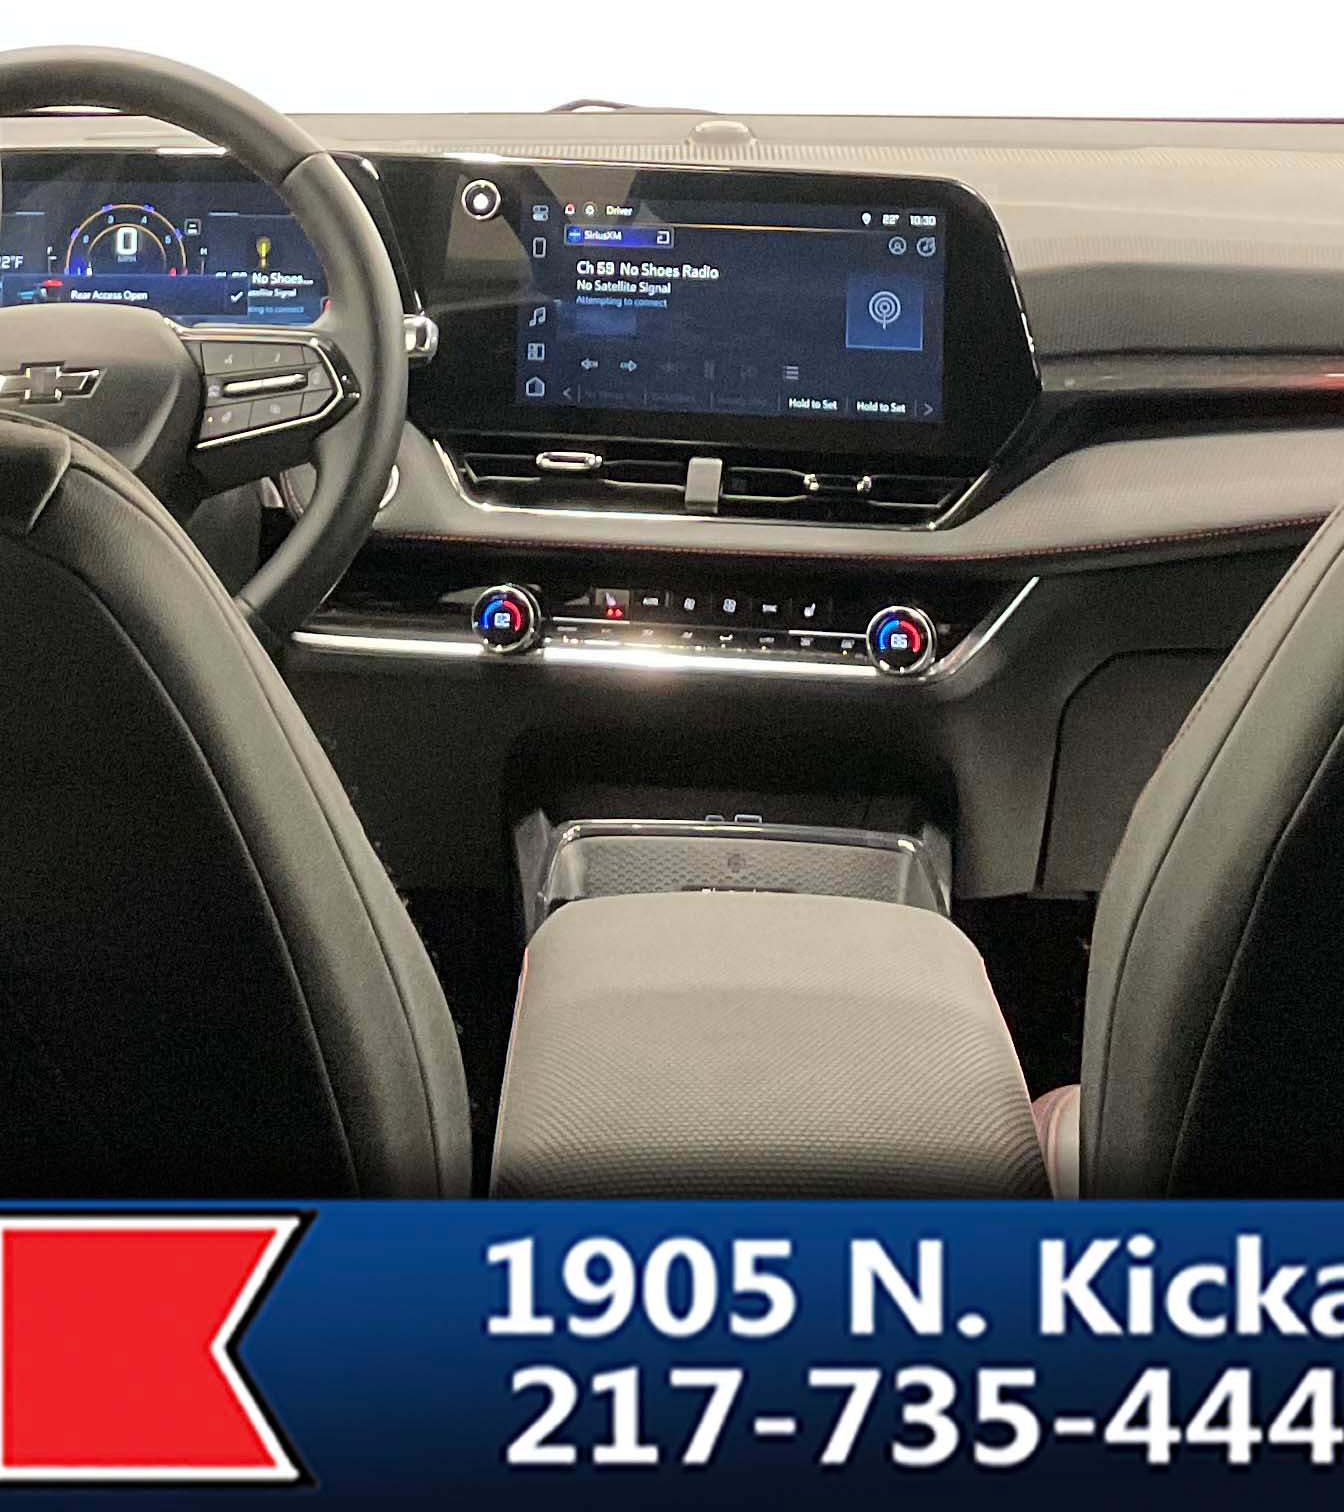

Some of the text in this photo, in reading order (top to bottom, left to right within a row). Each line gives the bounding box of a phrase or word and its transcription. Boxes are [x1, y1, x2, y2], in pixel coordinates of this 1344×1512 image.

[606, 205, 633, 216] Driver
[910, 215, 937, 226] 10:30
[116, 227, 138, 256] 0
[584, 230, 623, 242] SiriusXM
[576, 260, 594, 275] Ch
[619, 262, 640, 277] No
[641, 263, 680, 278] Shoes
[682, 264, 720, 279] Radio
[252, 272, 269, 284] No
[576, 279, 672, 296] No Satellite Signal
[70, 289, 149, 303] Rear Access Open
[788, 397, 837, 411] Hold to Set
[856, 401, 906, 413] Hold to Set
